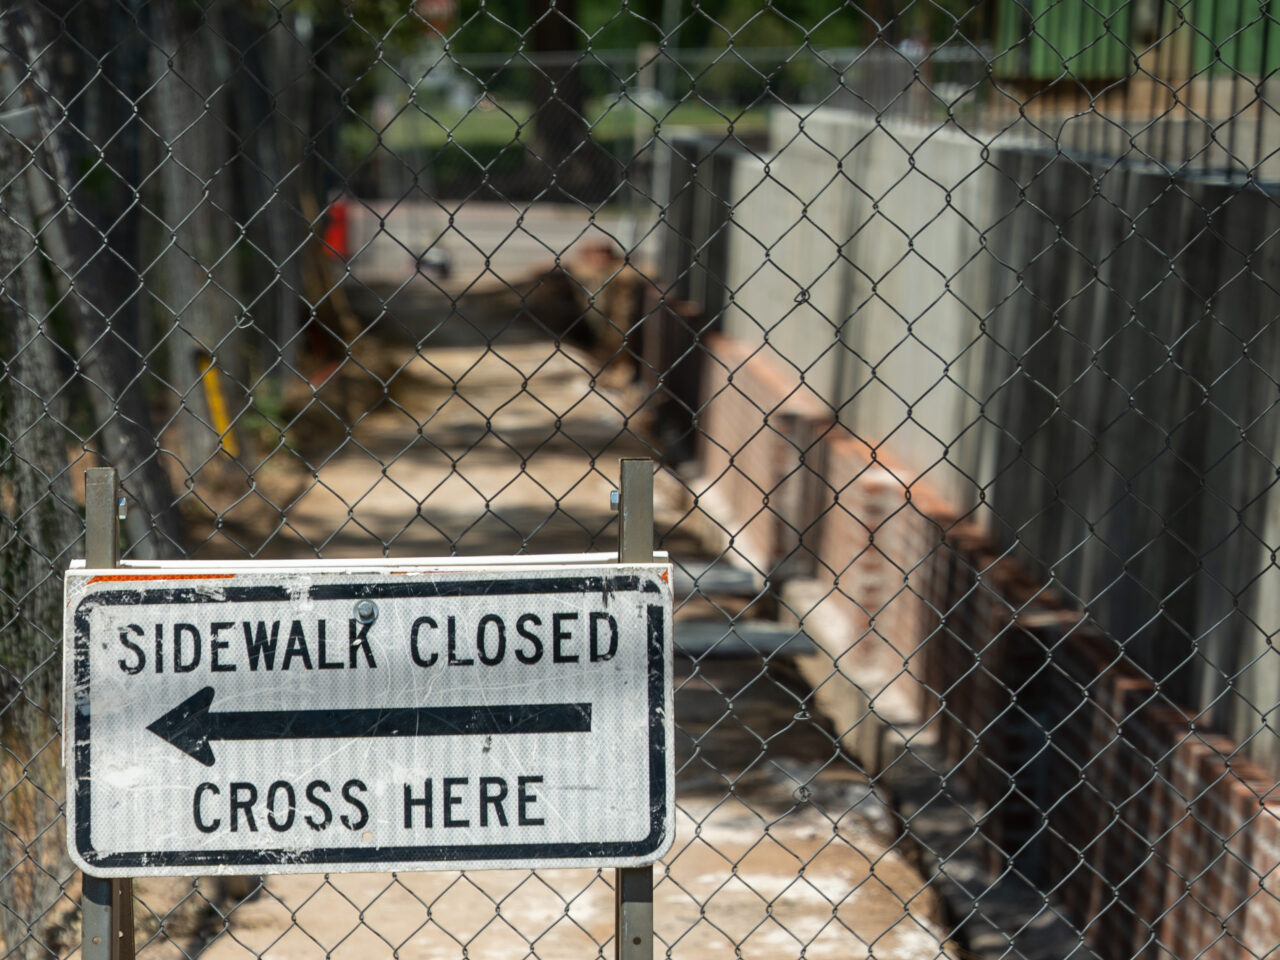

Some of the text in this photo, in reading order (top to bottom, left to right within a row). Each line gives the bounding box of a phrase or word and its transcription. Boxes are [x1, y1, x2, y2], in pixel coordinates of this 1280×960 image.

[119, 611, 620, 674] SIDEWALK CLOSED
[193, 775, 546, 834] CROSS HERE
